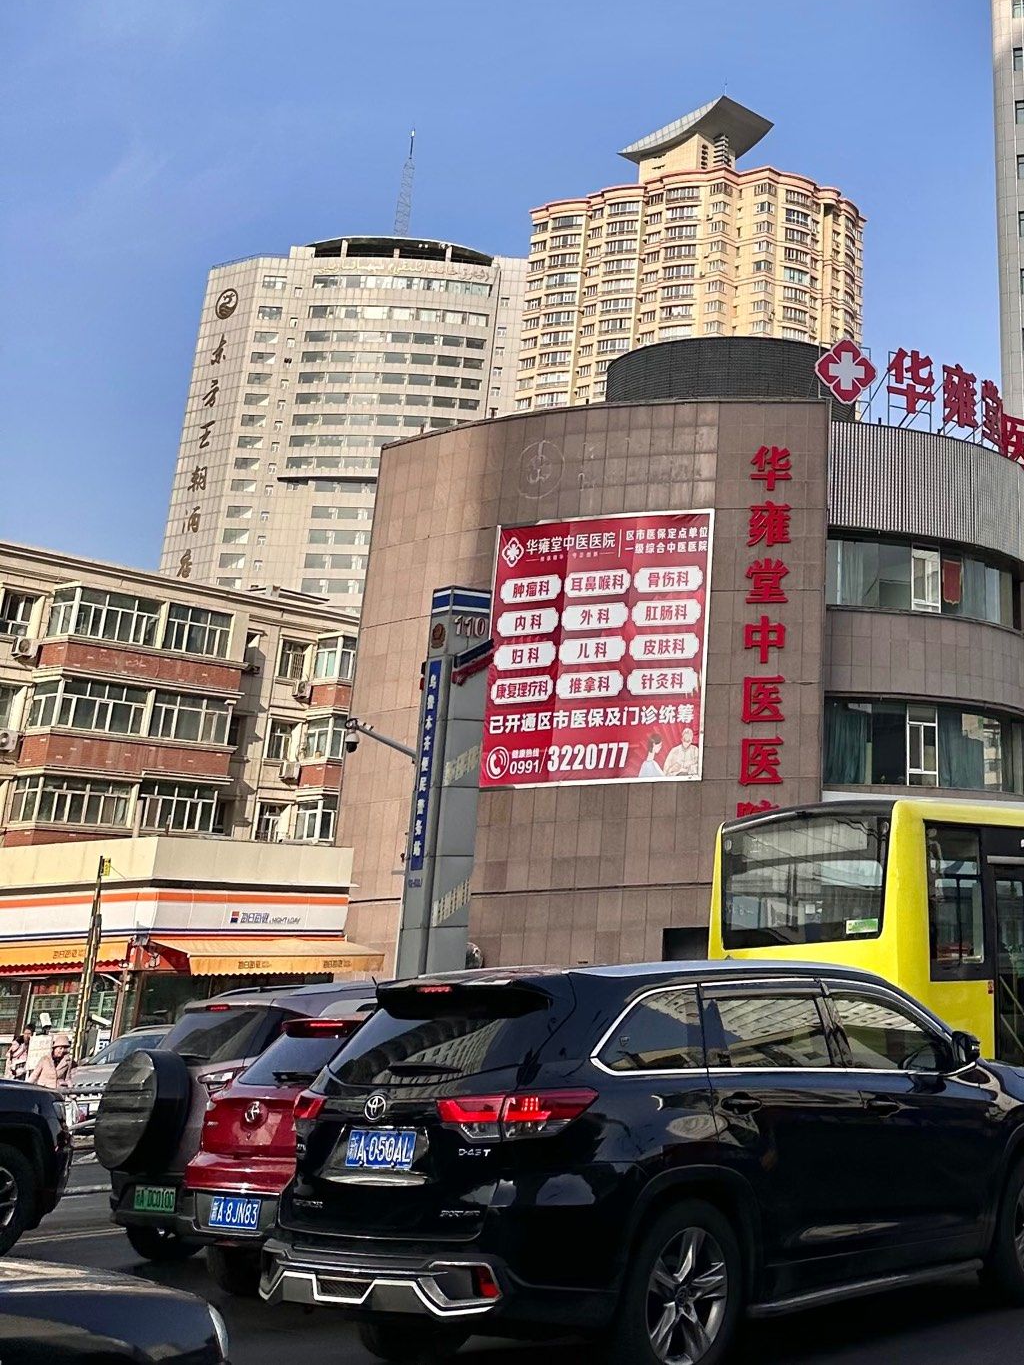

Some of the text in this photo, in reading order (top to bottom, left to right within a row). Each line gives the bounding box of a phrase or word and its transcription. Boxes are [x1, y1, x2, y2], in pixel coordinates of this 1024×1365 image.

[176, 333, 227, 579] 东方王朝酒店
[626, 526, 708, 542] 区市医保定点单位
[526, 532, 616, 555] 华雍堂中医医院
[625, 541, 708, 555] 一级综合中医医院
[571, 573, 625, 593] 耳鼻喉科
[647, 570, 689, 588] 骨伤科
[512, 580, 550, 598] 肿瘤科
[579, 608, 610, 625] 外科
[645, 604, 687, 621] 肛肠科
[454, 615, 486, 637] 110
[514, 614, 542, 631] 内科
[577, 641, 607, 659] 儿科
[643, 638, 685, 655] 皮肤科
[511, 647, 539, 665] 妇科
[495, 679, 548, 699] 康复理疗科
[569, 675, 610, 694] 推拿科
[641, 672, 683, 690] 针灸科
[489, 703, 694, 734] 已开通区市医保及门诊统筹
[547, 742, 629, 772] 3220777
